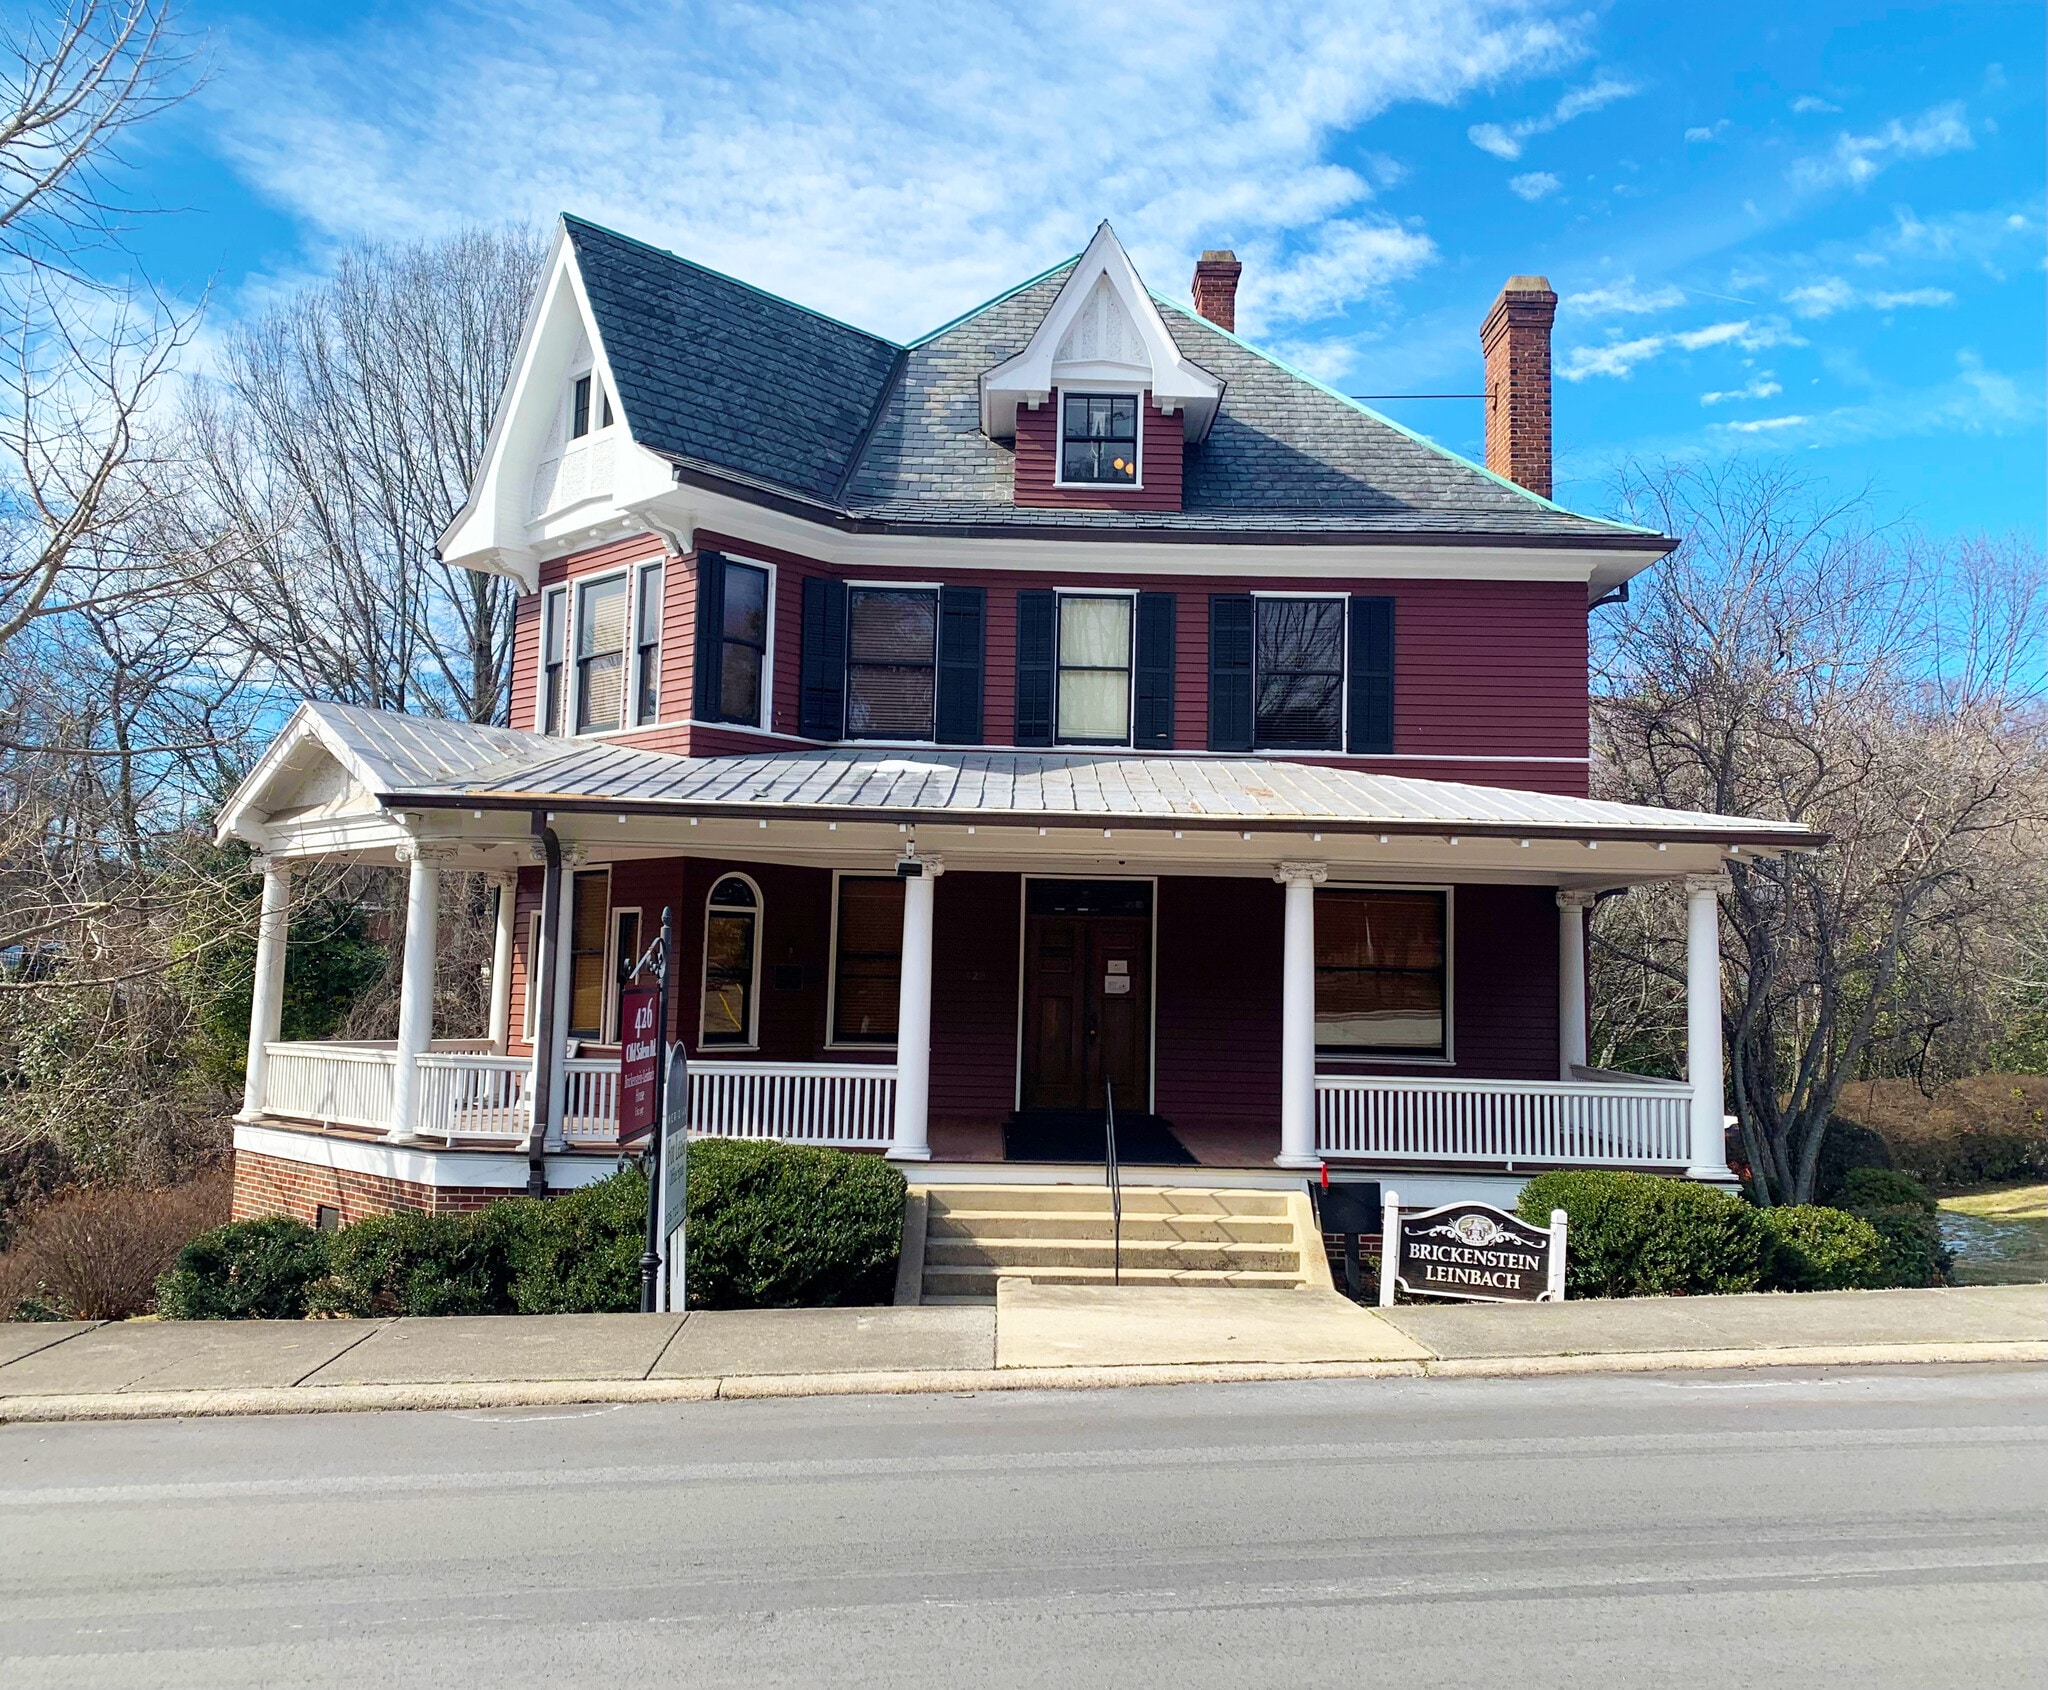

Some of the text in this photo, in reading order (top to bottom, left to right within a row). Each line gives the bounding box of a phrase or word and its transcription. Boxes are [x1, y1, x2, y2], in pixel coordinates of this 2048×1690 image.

[634, 997, 654, 1039] 426
[626, 1042, 637, 1063] Old
[636, 1040, 650, 1061] Salem
[667, 1138, 675, 1167] For
[1409, 1243, 1540, 1271] BRICKENSTEIN
[1425, 1265, 1521, 1290] LEINBACH
